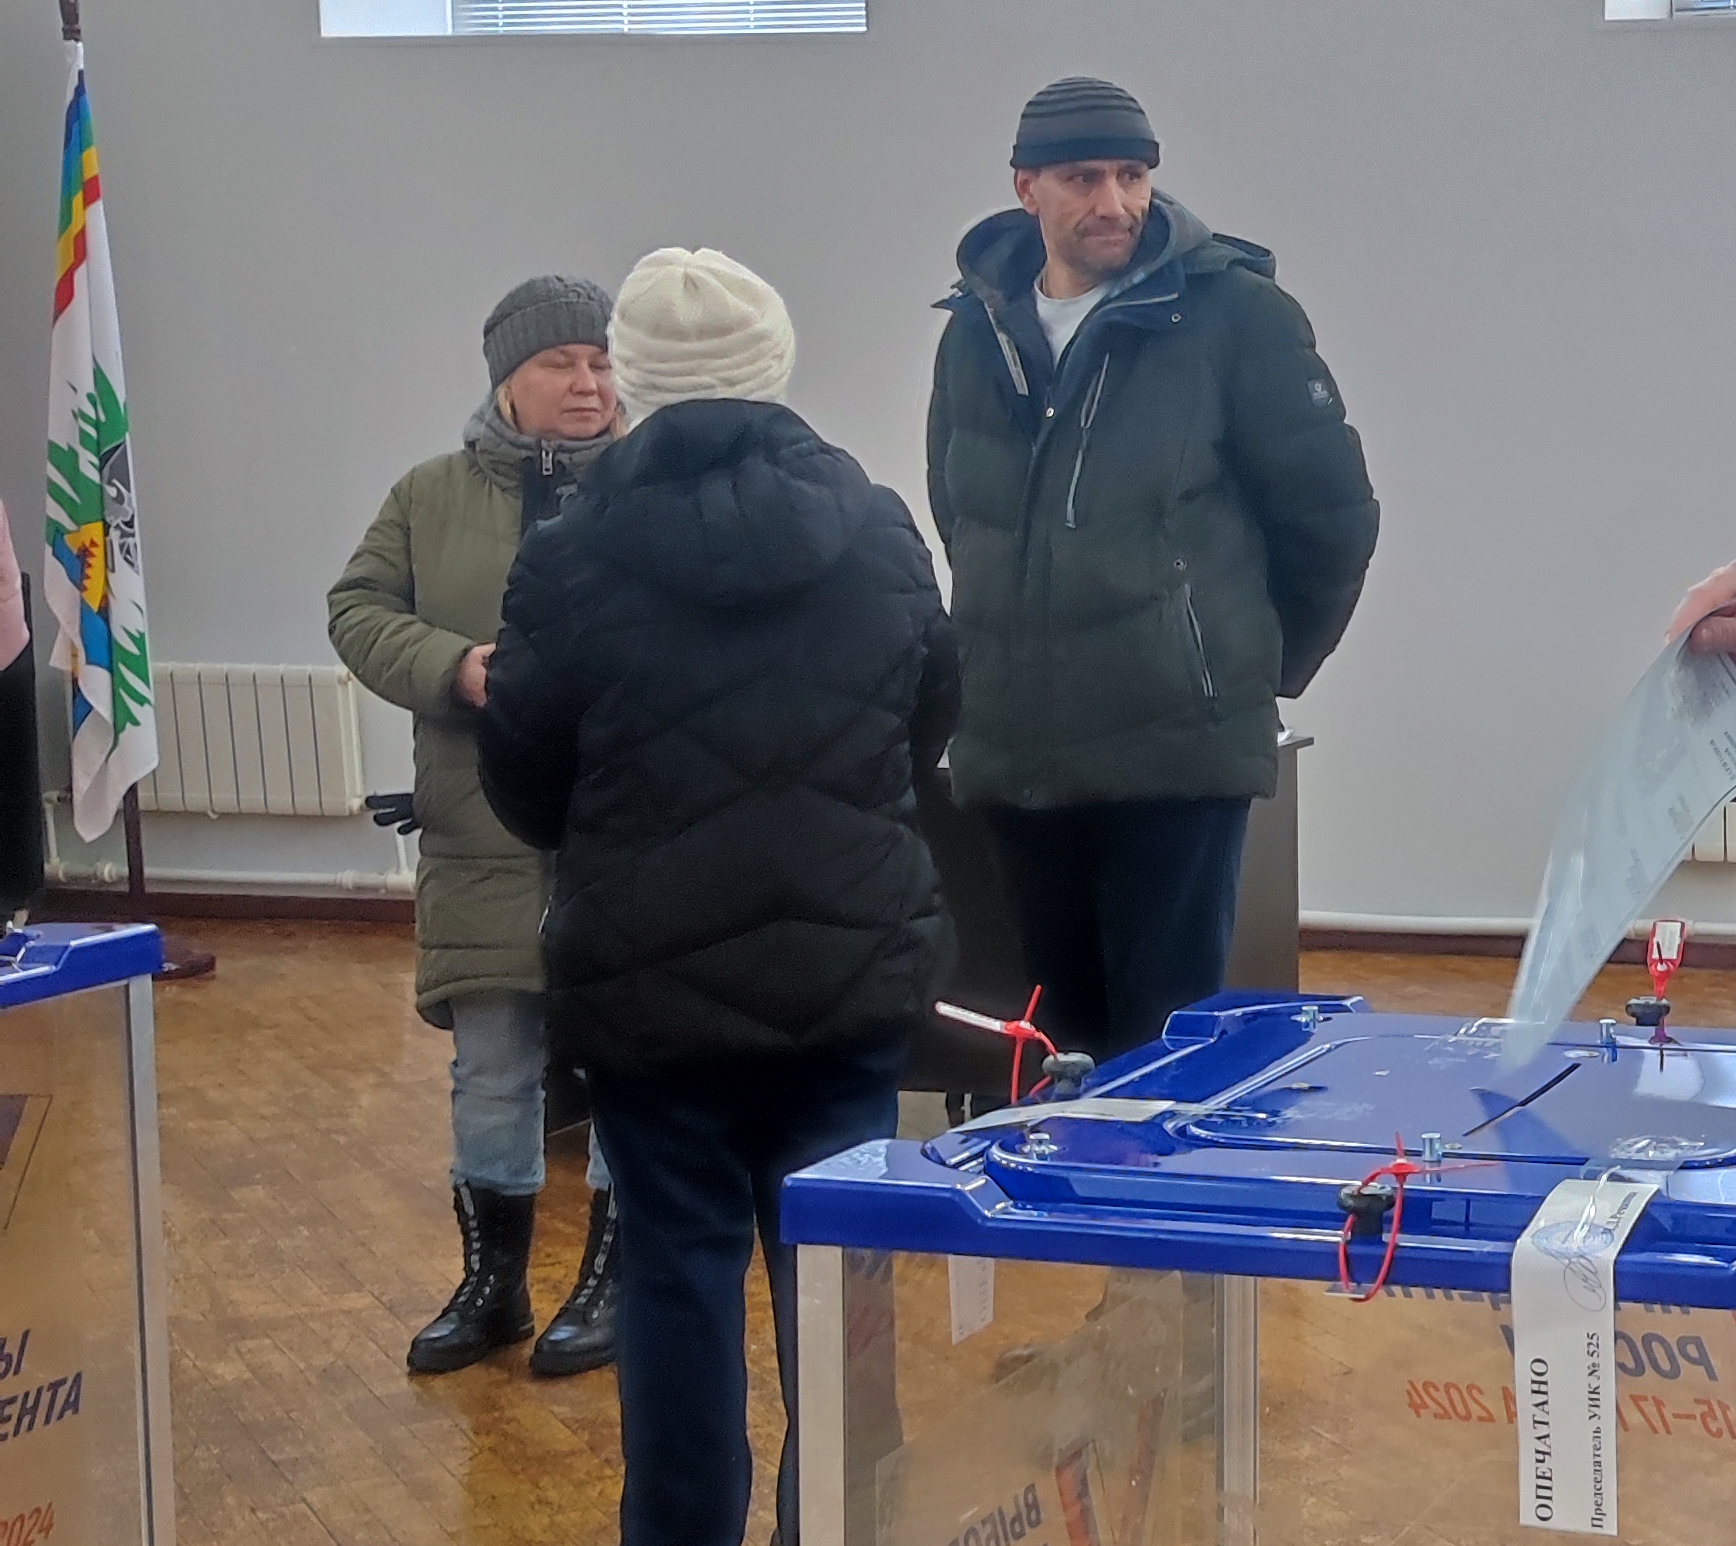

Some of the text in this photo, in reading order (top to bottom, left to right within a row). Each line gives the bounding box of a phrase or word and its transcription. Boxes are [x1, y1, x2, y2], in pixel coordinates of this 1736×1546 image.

[1586, 1331, 1600, 1359] 525
[1587, 1382, 1602, 1421] УИК
[1529, 1357, 1554, 1523] ОПЕЧАТАНО
[1589, 1426, 1606, 1530] Председатель
